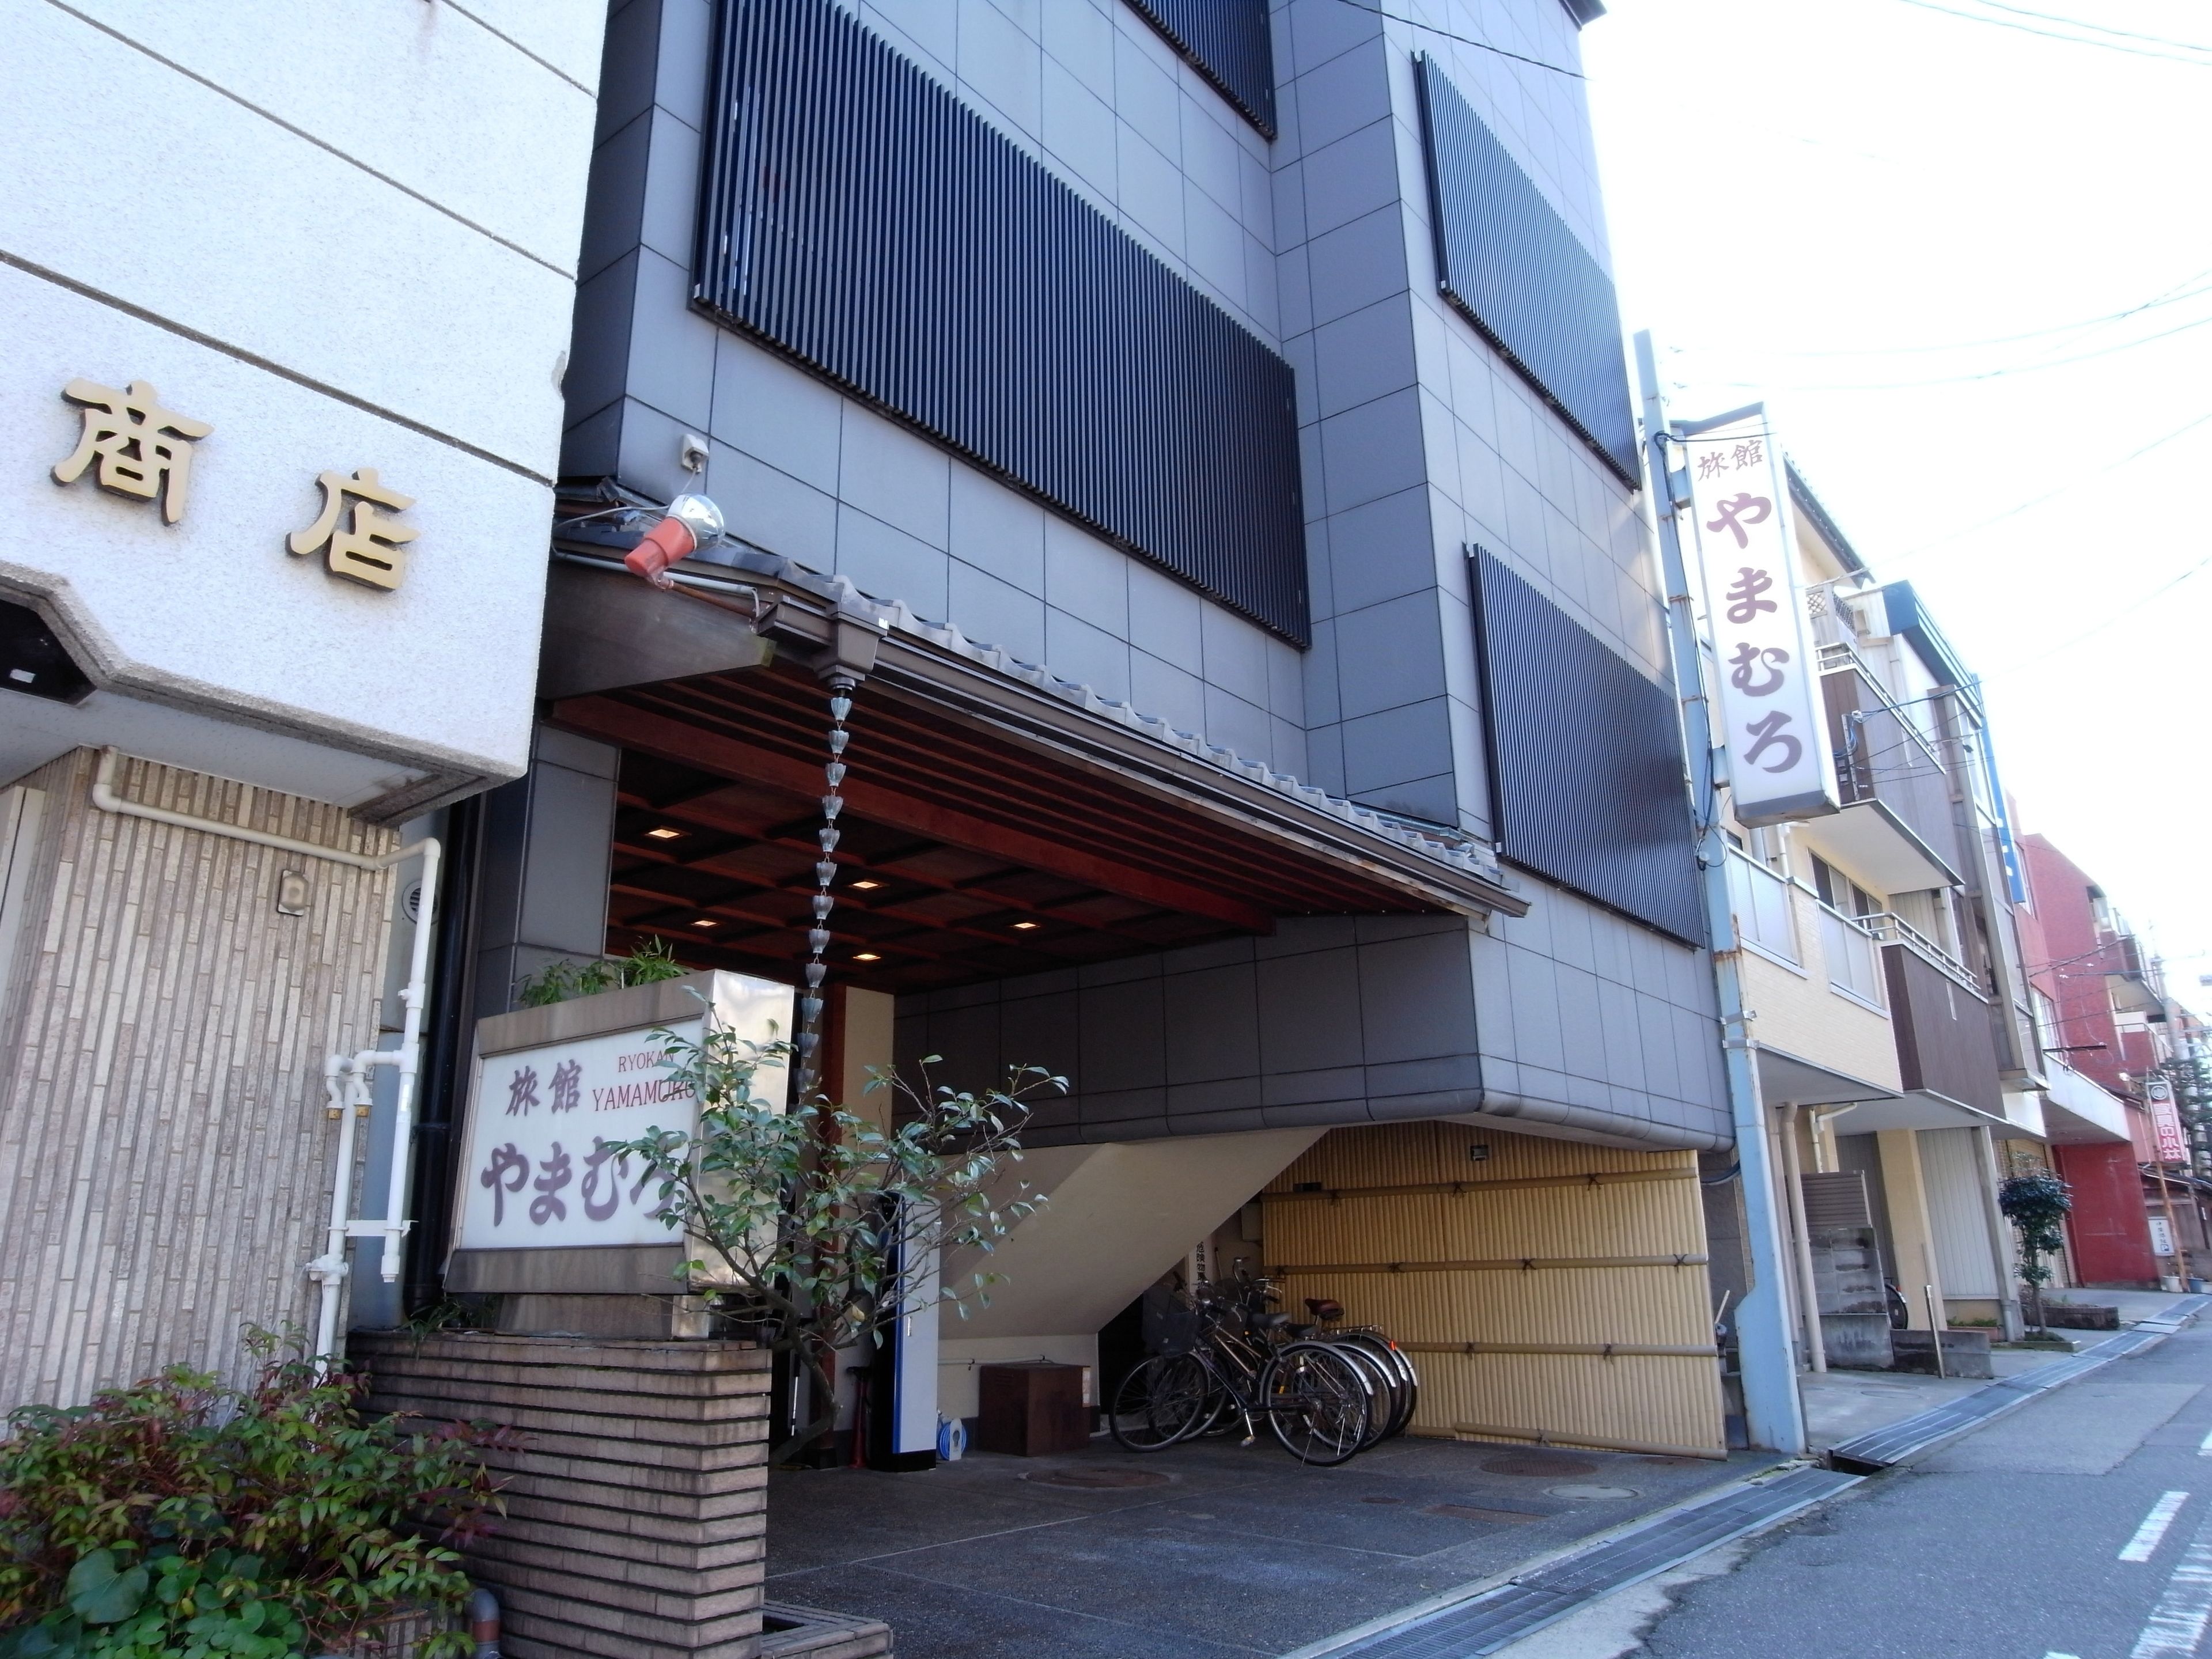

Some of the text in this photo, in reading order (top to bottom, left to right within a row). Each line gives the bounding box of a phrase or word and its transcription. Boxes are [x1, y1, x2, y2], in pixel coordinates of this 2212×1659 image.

[50, 377, 421, 592] 商店
[1697, 440, 1764, 482] 旅館
[1706, 492, 1802, 774] やまむろ
[506, 1058, 583, 1118] 旅館
